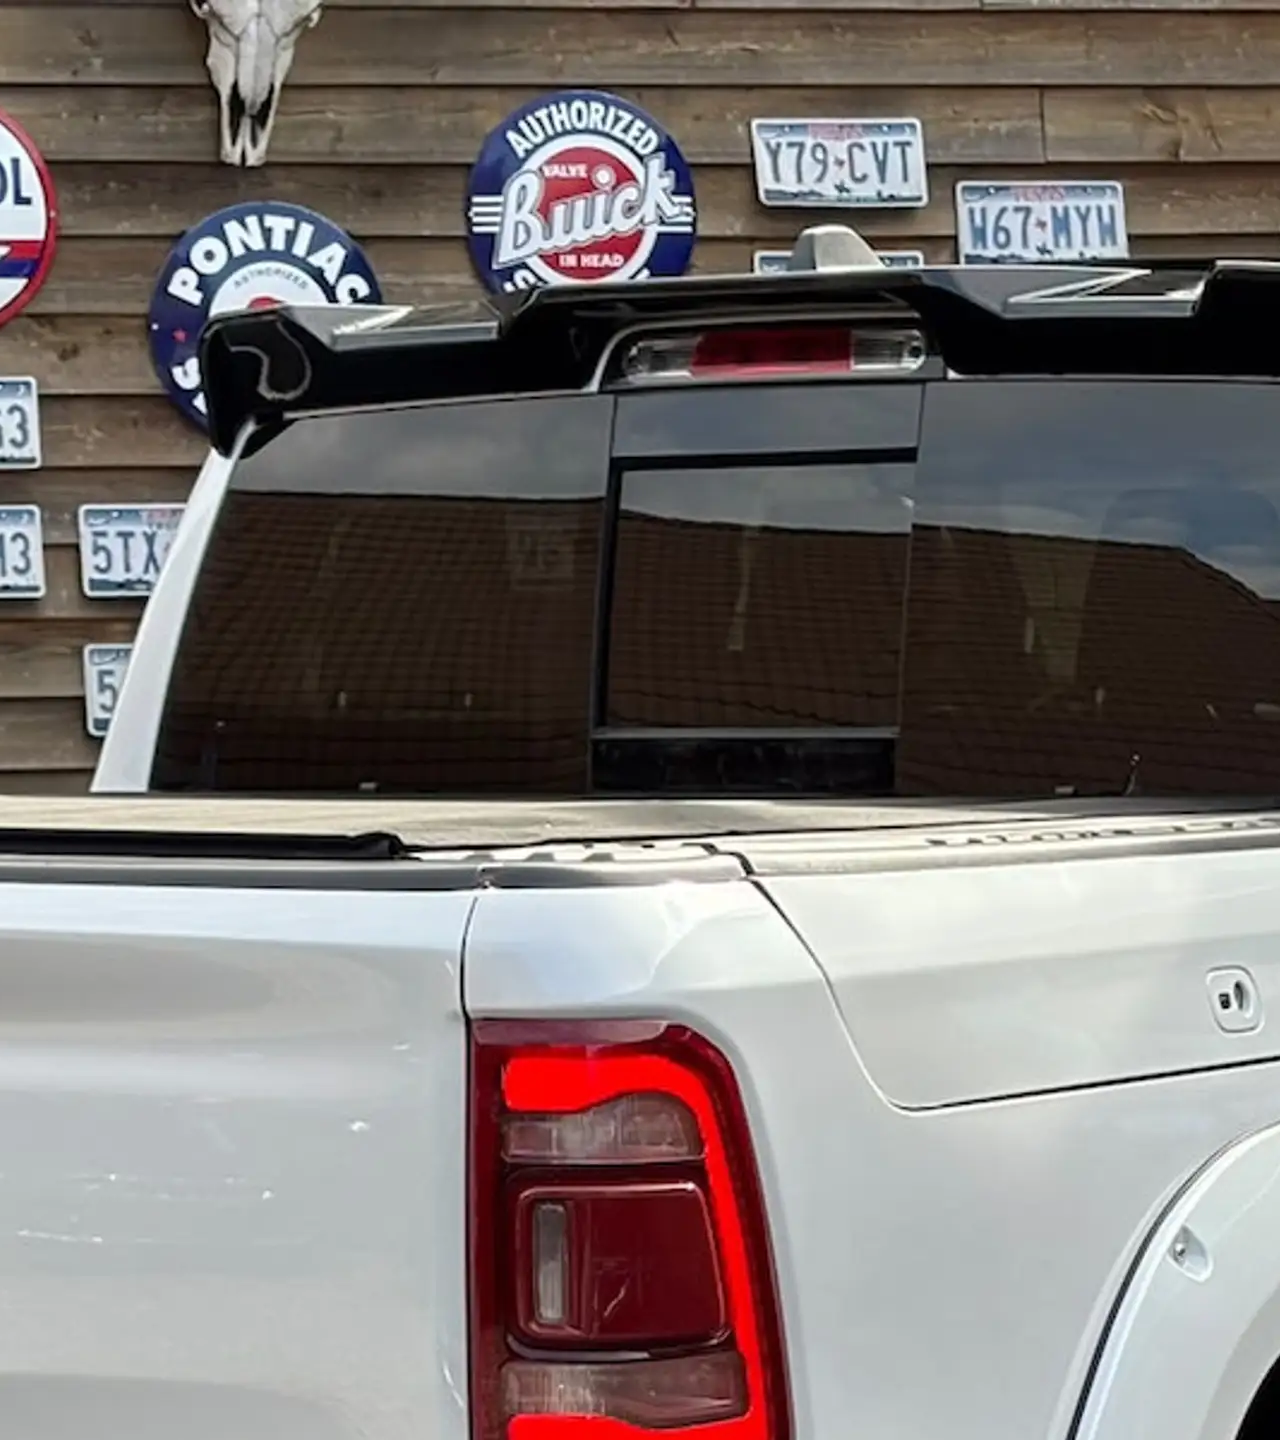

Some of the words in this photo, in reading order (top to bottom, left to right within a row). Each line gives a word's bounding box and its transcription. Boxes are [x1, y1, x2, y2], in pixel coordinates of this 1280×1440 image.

[506, 99, 659, 158] AUTHORIZED
[541, 164, 588, 179] VALVE
[764, 141, 829, 184] Y79
[846, 141, 913, 184] CVT
[492, 151, 682, 270] Buick
[167, 214, 371, 306] PONTIAC
[558, 254, 578, 267] IN
[581, 254, 624, 267] HEAD
